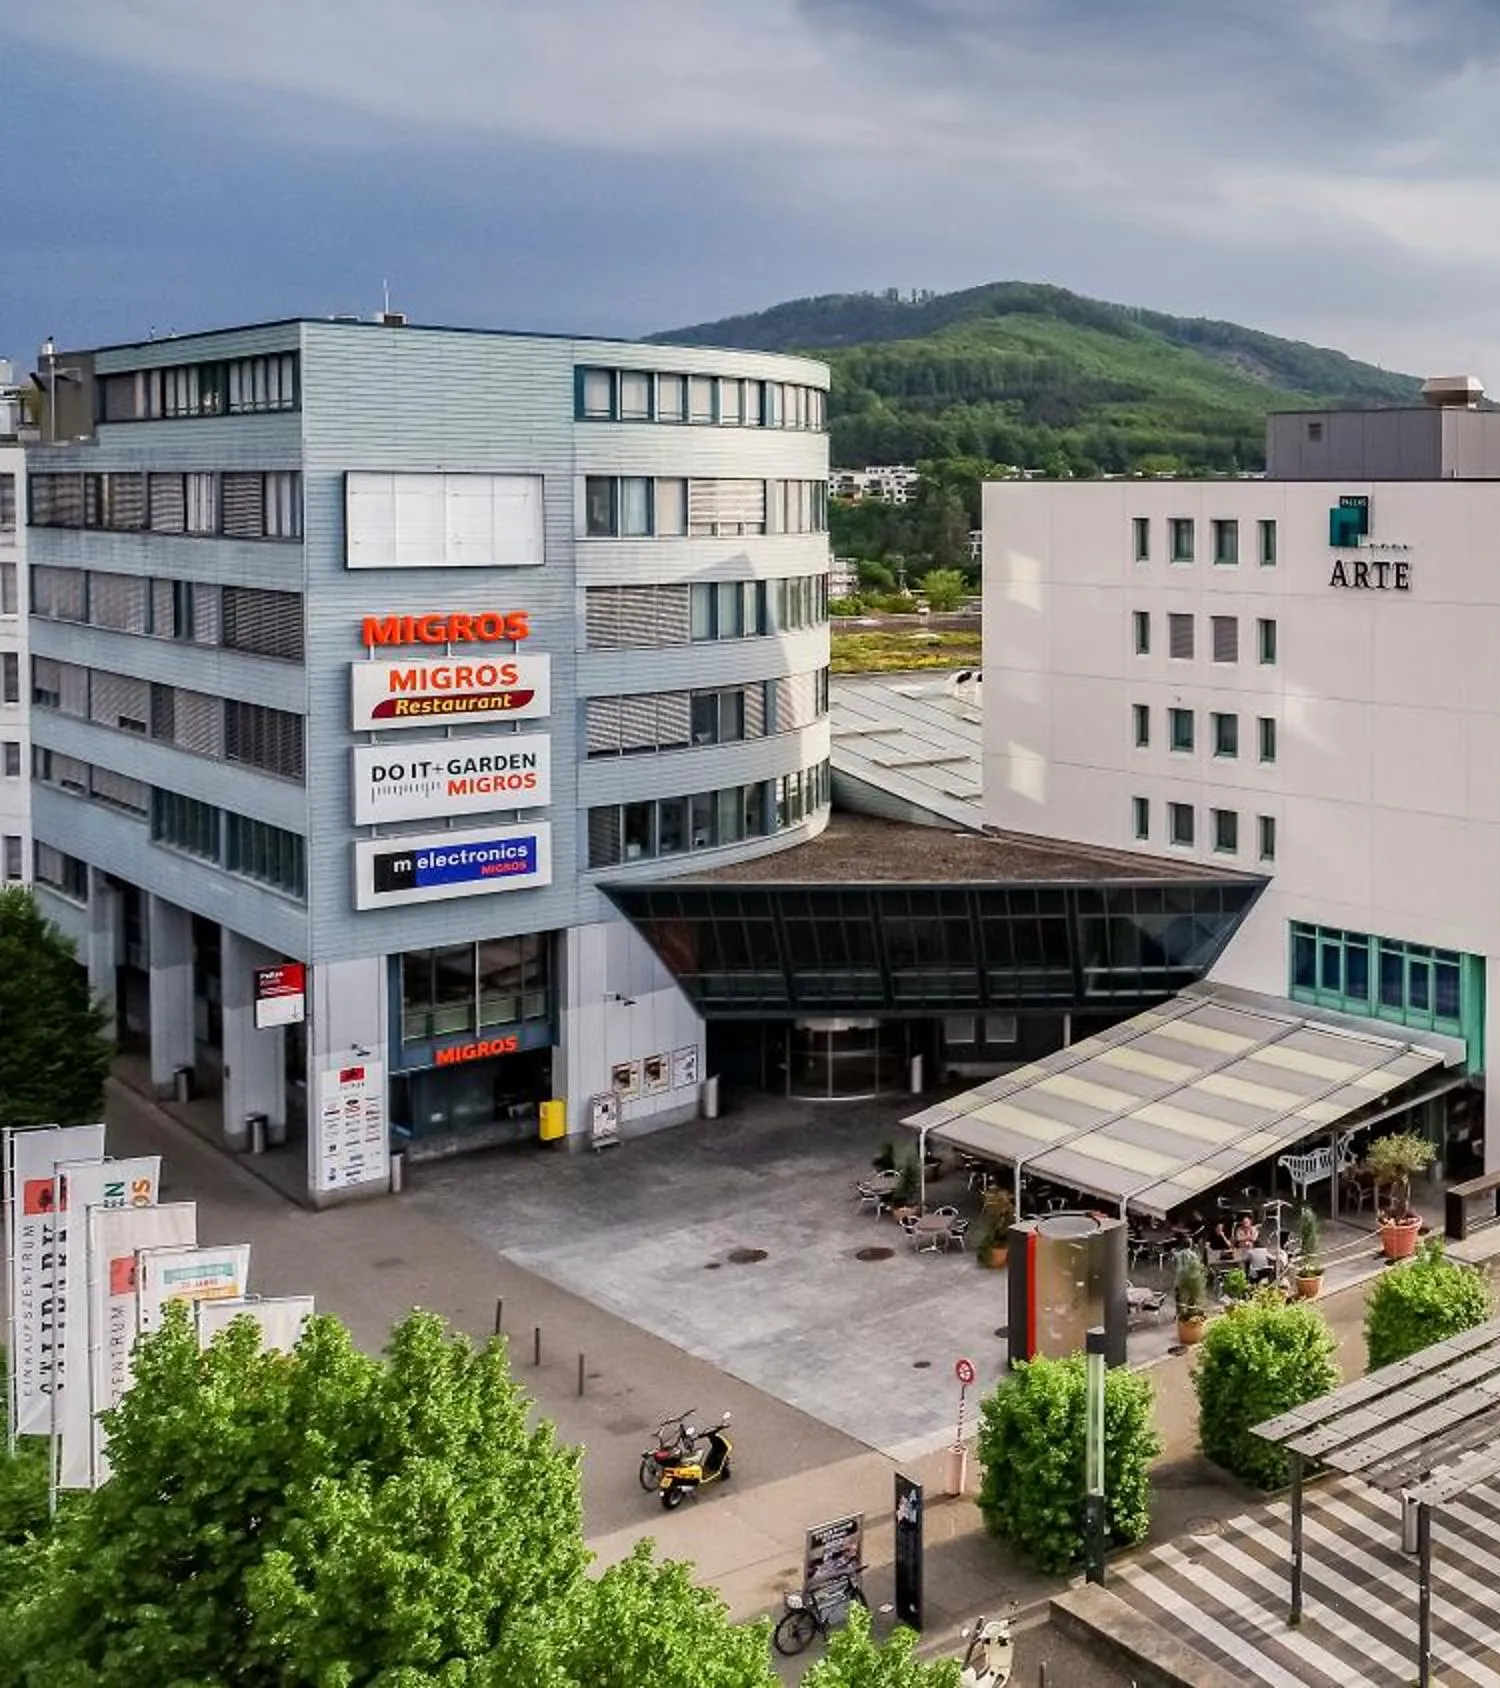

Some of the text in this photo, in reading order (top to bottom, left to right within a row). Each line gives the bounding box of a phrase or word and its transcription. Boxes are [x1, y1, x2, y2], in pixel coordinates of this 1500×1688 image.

[1328, 560, 1409, 589] ARTE
[361, 611, 529, 645] MIGROS
[389, 663, 519, 692] MIGROS
[395, 694, 512, 715] Restaurant
[372, 765, 404, 783] DO
[447, 773, 537, 797] MIGROS
[393, 843, 528, 873] m electronics
[480, 861, 528, 876] MIGROS
[435, 1036, 517, 1066] MIGROS
